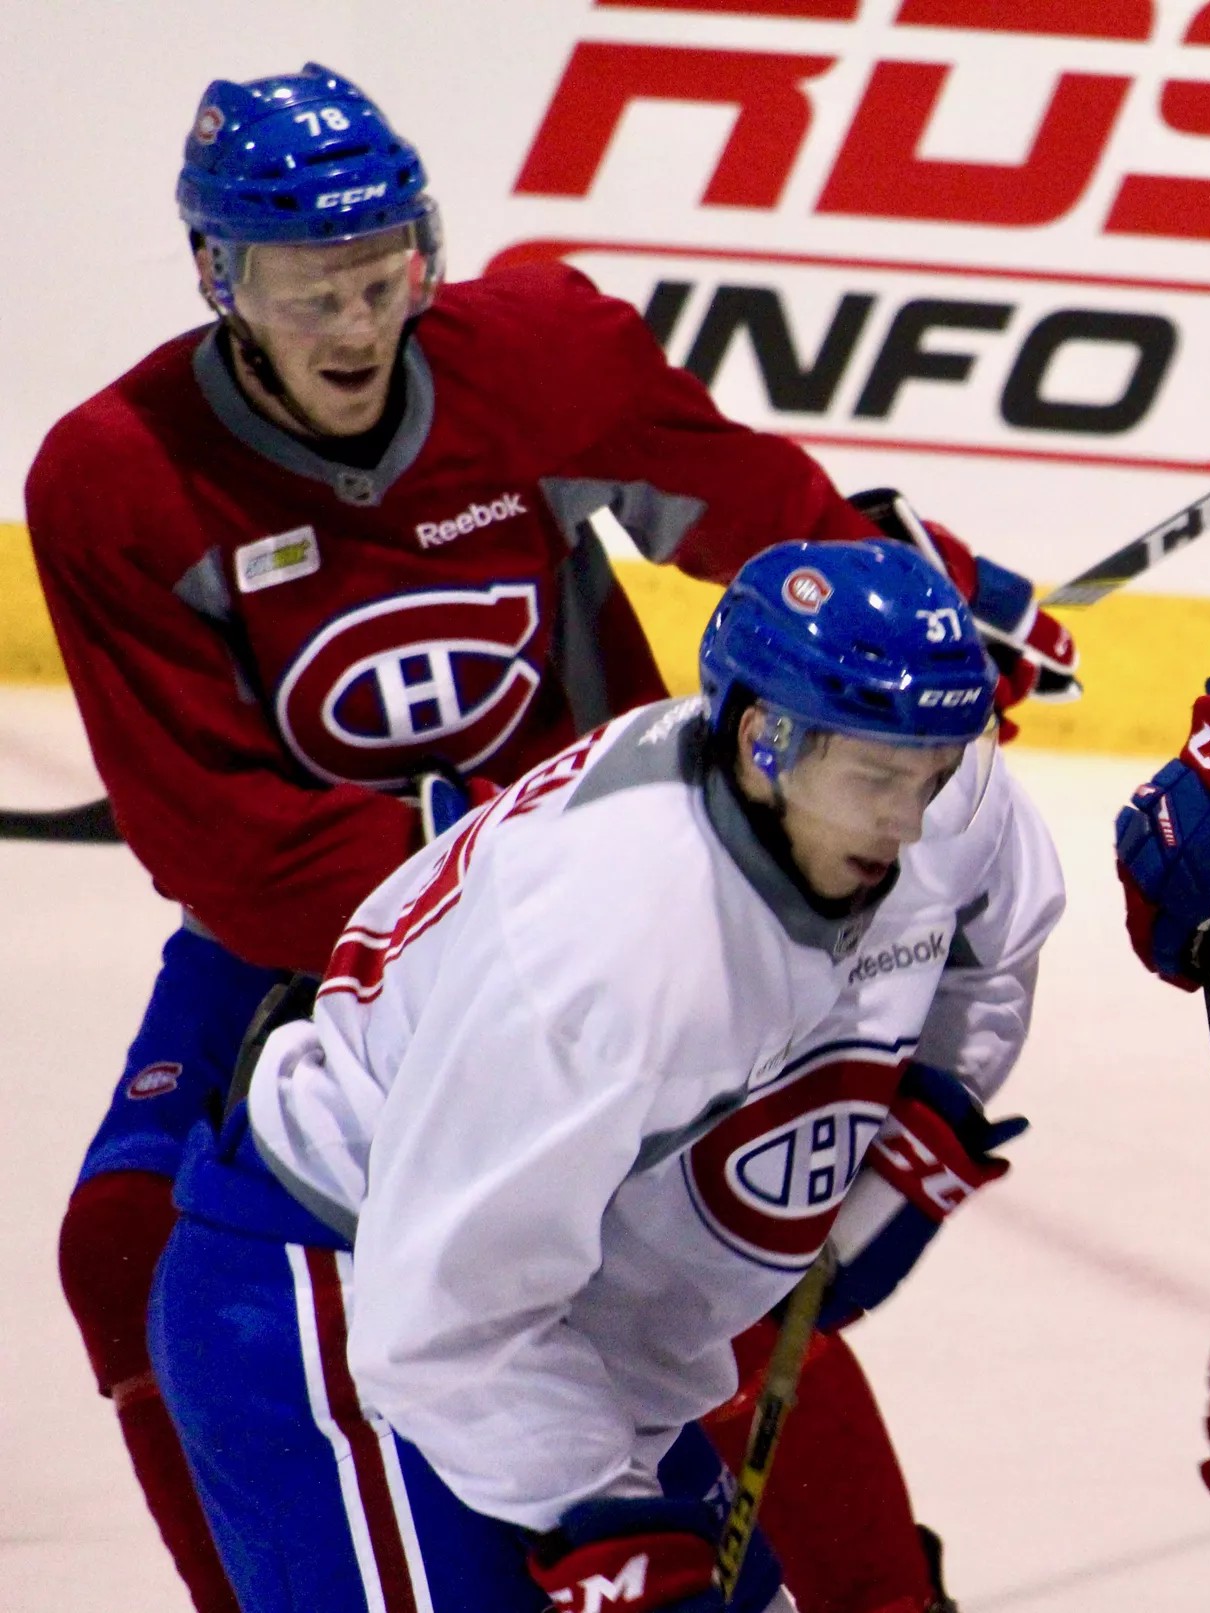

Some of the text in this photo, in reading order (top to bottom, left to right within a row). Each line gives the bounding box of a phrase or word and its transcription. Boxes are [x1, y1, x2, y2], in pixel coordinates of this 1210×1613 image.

[295, 107, 350, 137] 78
[316, 183, 386, 209] CCM
[645, 280, 1180, 437] INFO
[416, 493, 527, 550] Reebok
[916, 608, 963, 642] 37
[918, 688, 983, 708] CCM
[848, 932, 945, 986] Reebok
